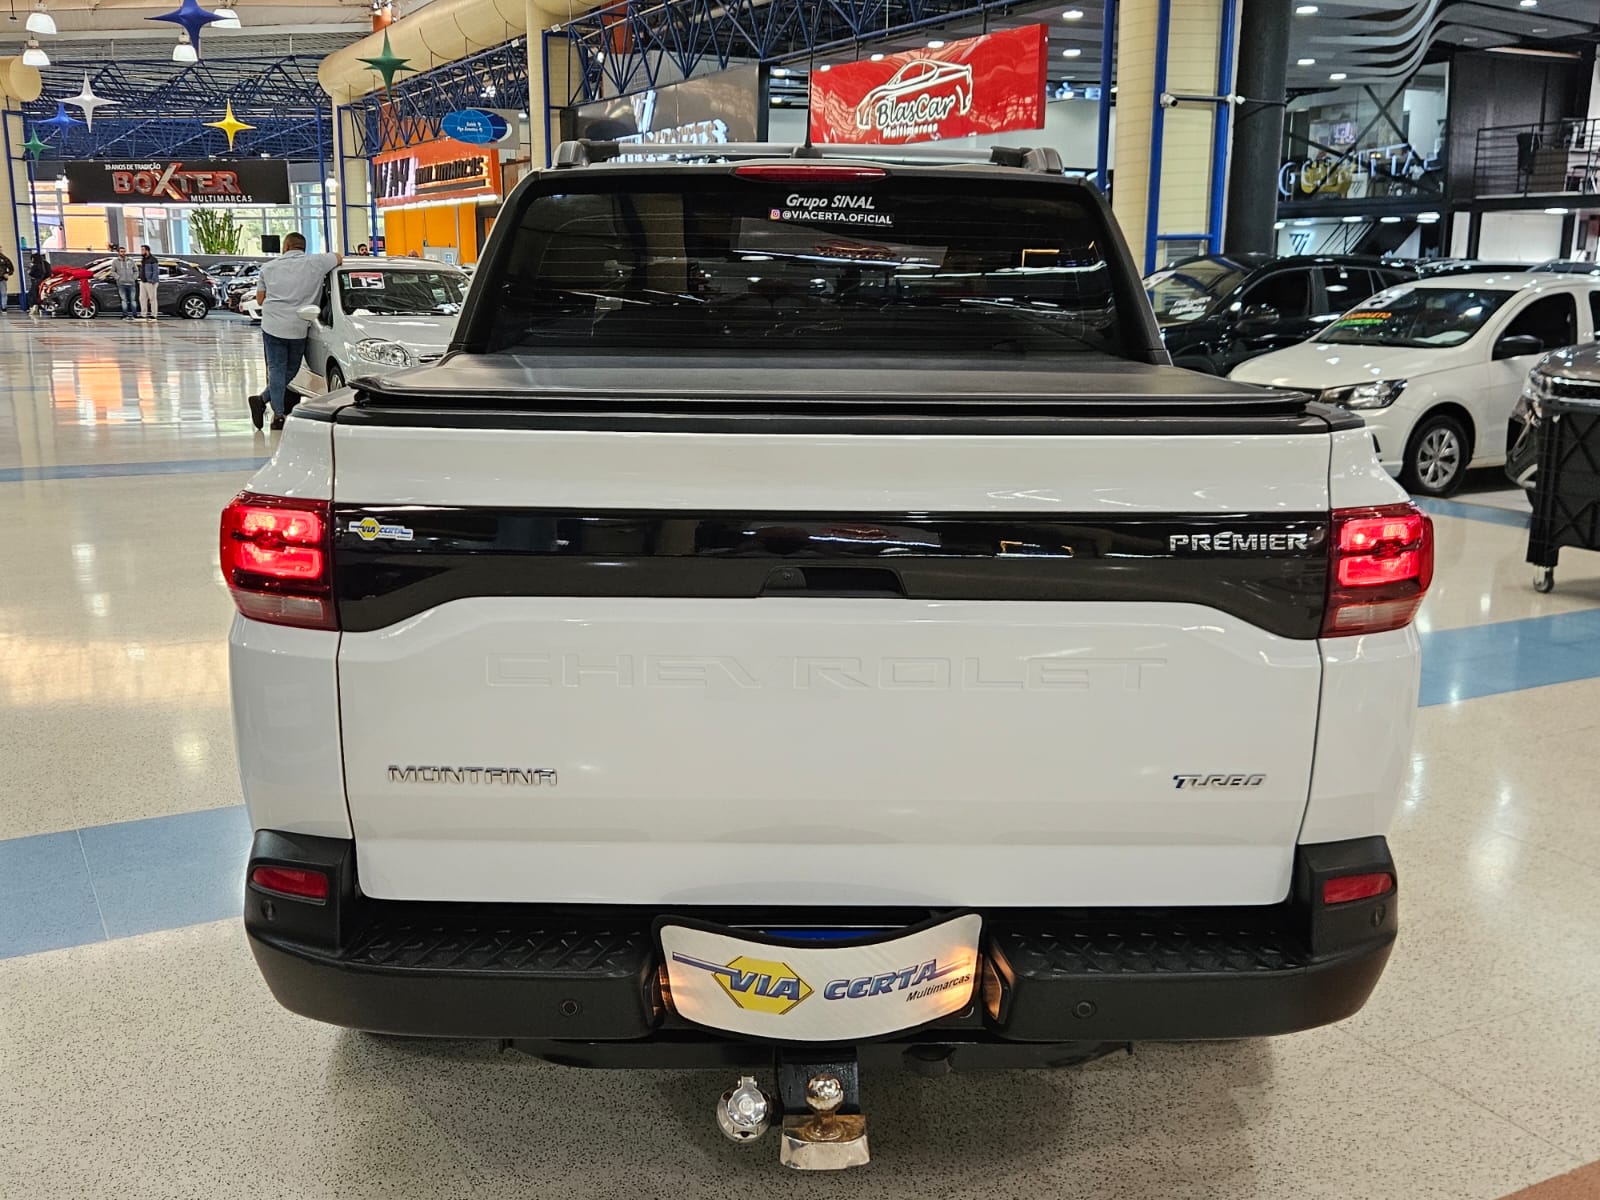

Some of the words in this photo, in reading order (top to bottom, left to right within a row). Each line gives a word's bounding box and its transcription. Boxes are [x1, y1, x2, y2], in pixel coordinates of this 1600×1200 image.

[876, 93, 955, 130] BlasCar
[112, 162, 242, 201] BOXTER
[190, 195, 253, 203] MULTIMARCAS
[786, 194, 828, 210] Grupo
[831, 195, 875, 209] SINAL
[782, 210, 893, 225] @VIACERTA.OFICIAL
[486, 652, 1168, 692] CHEVROLET
[387, 765, 558, 786] MONTANA
[1172, 774, 1267, 789] TURBO
[729, 968, 801, 1001] VIA
[906, 973, 972, 1003] Multimarcas
